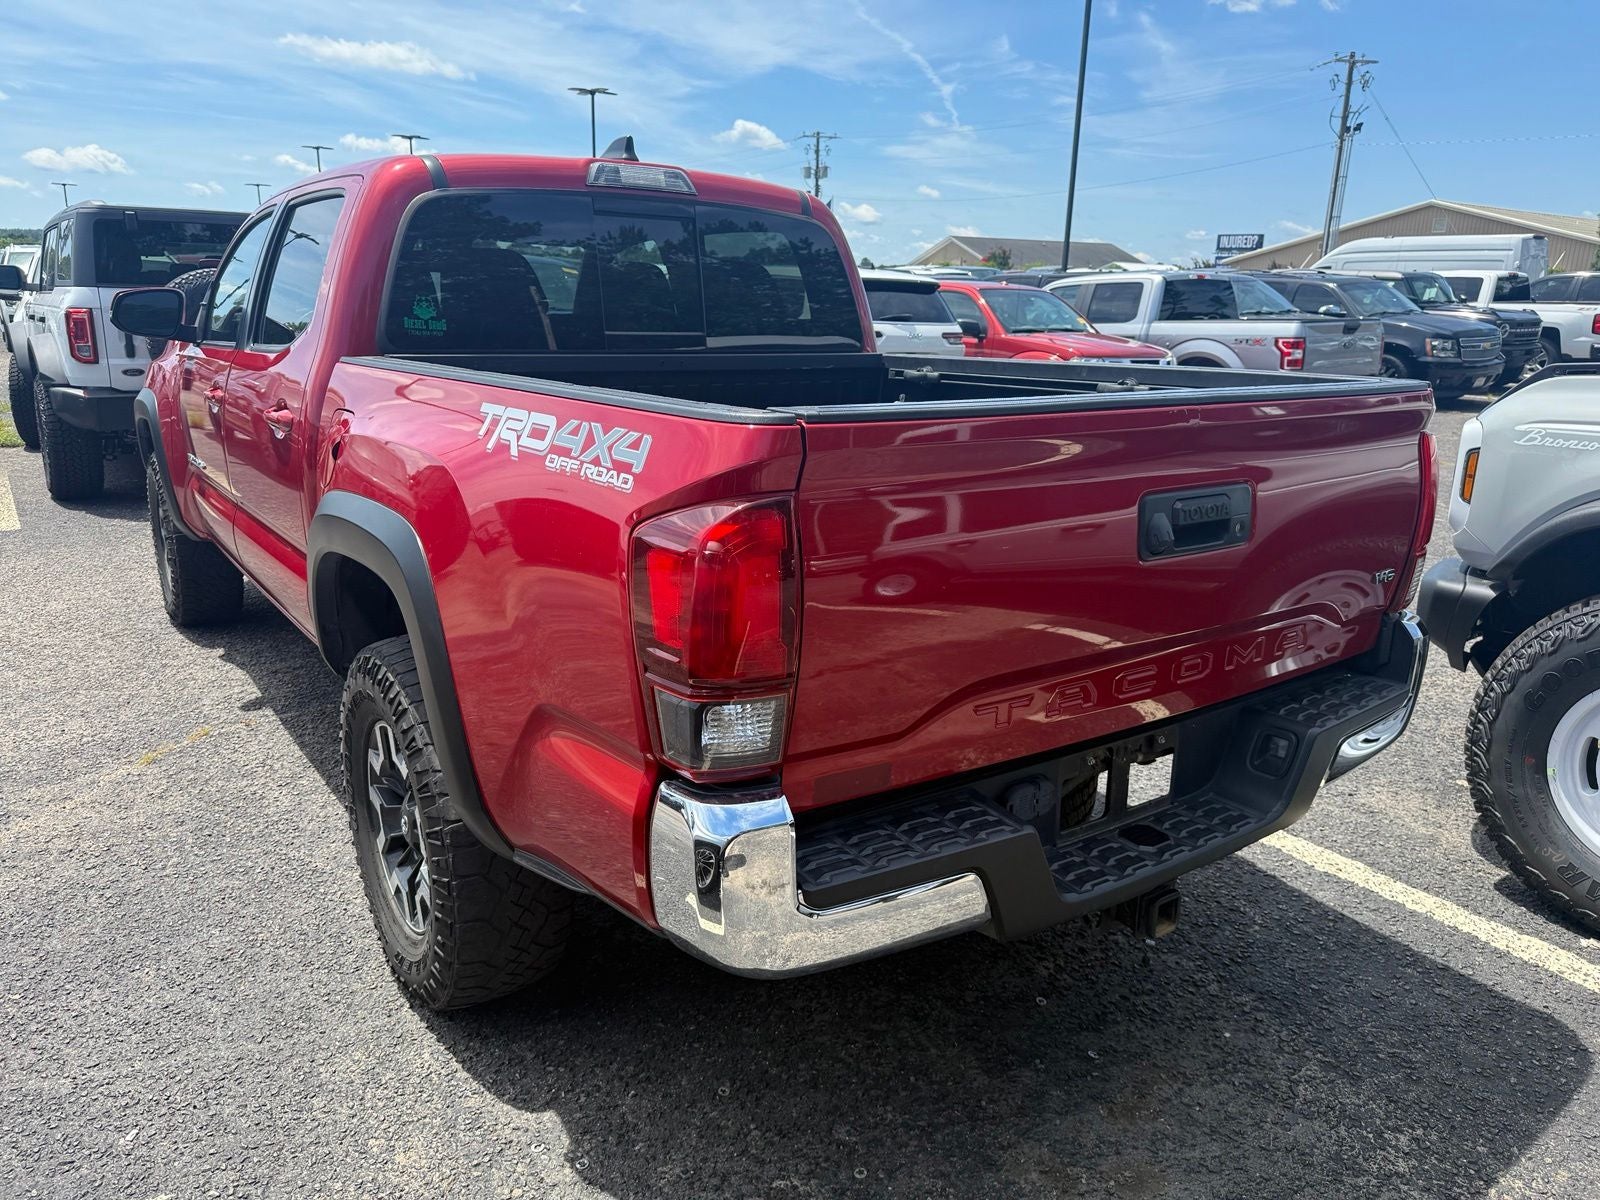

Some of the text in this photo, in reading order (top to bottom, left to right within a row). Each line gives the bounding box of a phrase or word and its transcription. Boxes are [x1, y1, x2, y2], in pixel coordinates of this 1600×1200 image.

[1220, 235, 1258, 248] INJURED?
[477, 402, 653, 473] TRD 4X4
[1513, 427, 1600, 450] Bronco
[545, 453, 634, 493] OFF ROAD
[1181, 502, 1229, 520] TOYOTA
[972, 624, 1307, 729] TACOMA
